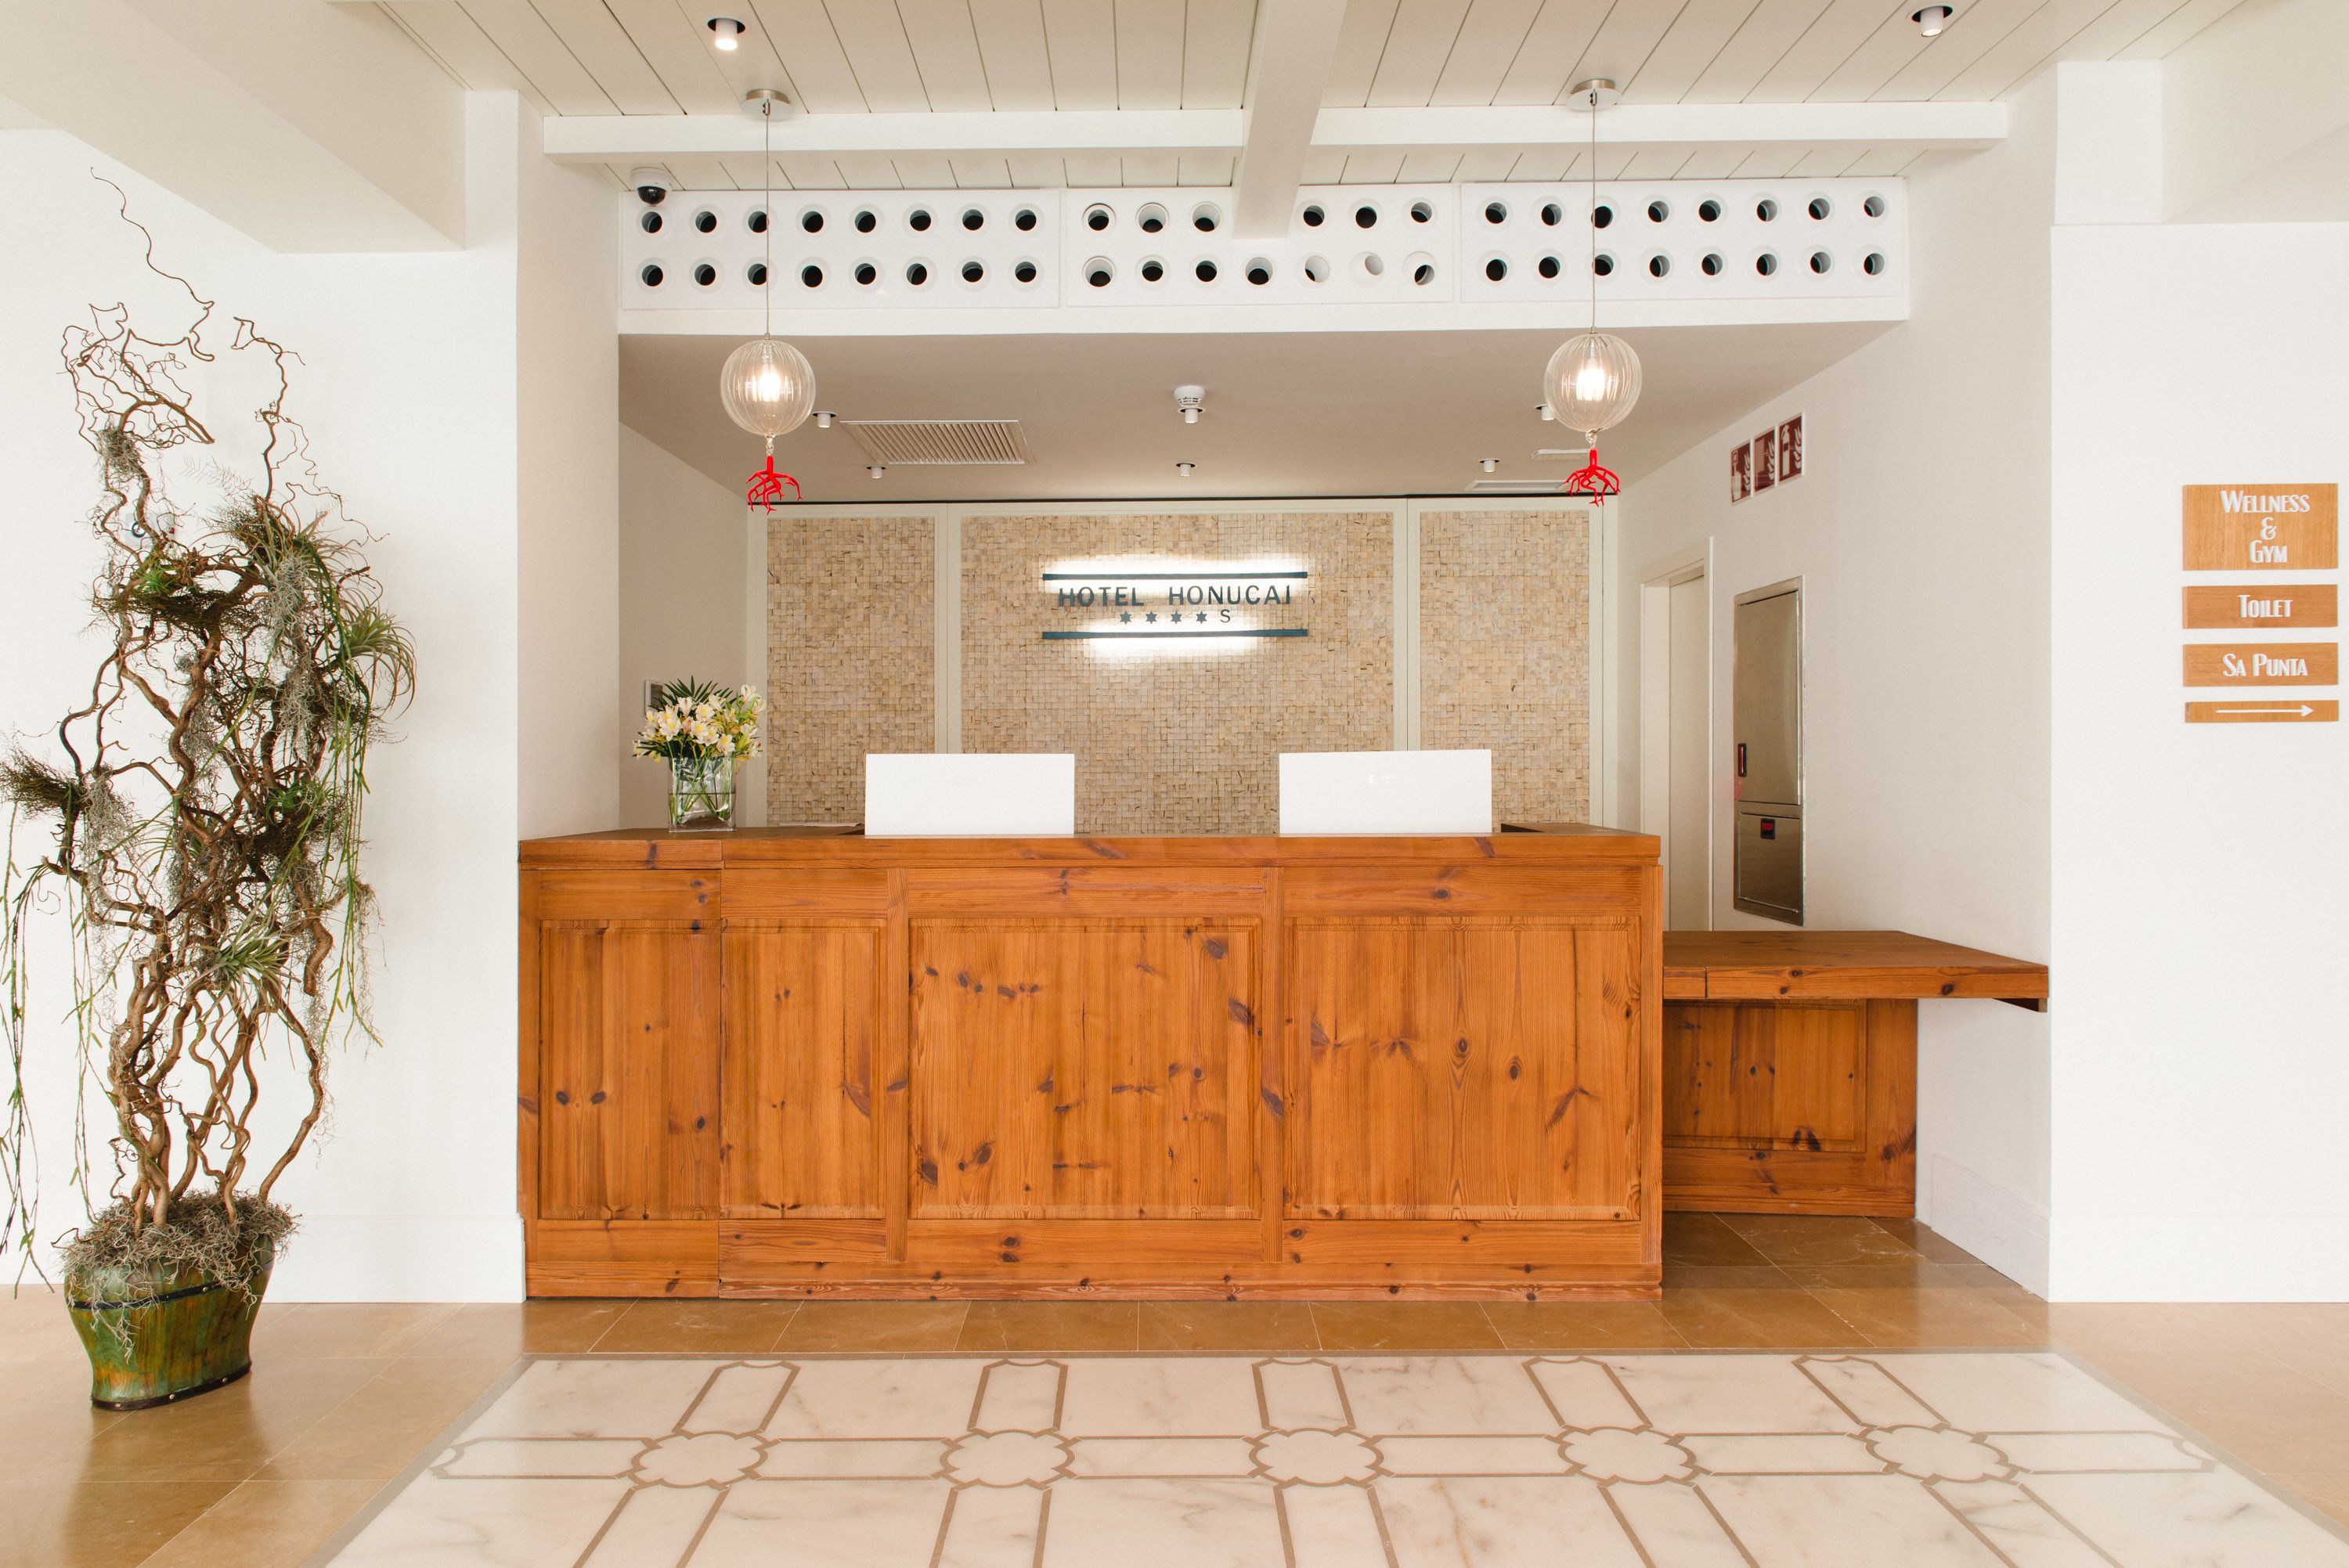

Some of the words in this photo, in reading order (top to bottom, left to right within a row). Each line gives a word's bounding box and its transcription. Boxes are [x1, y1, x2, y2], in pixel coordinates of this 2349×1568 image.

[2260, 517, 2277, 540] &
[1059, 586, 1144, 606] HOTEL
[1168, 585, 1290, 605] HONUCAI
[1220, 609, 1232, 623] S
